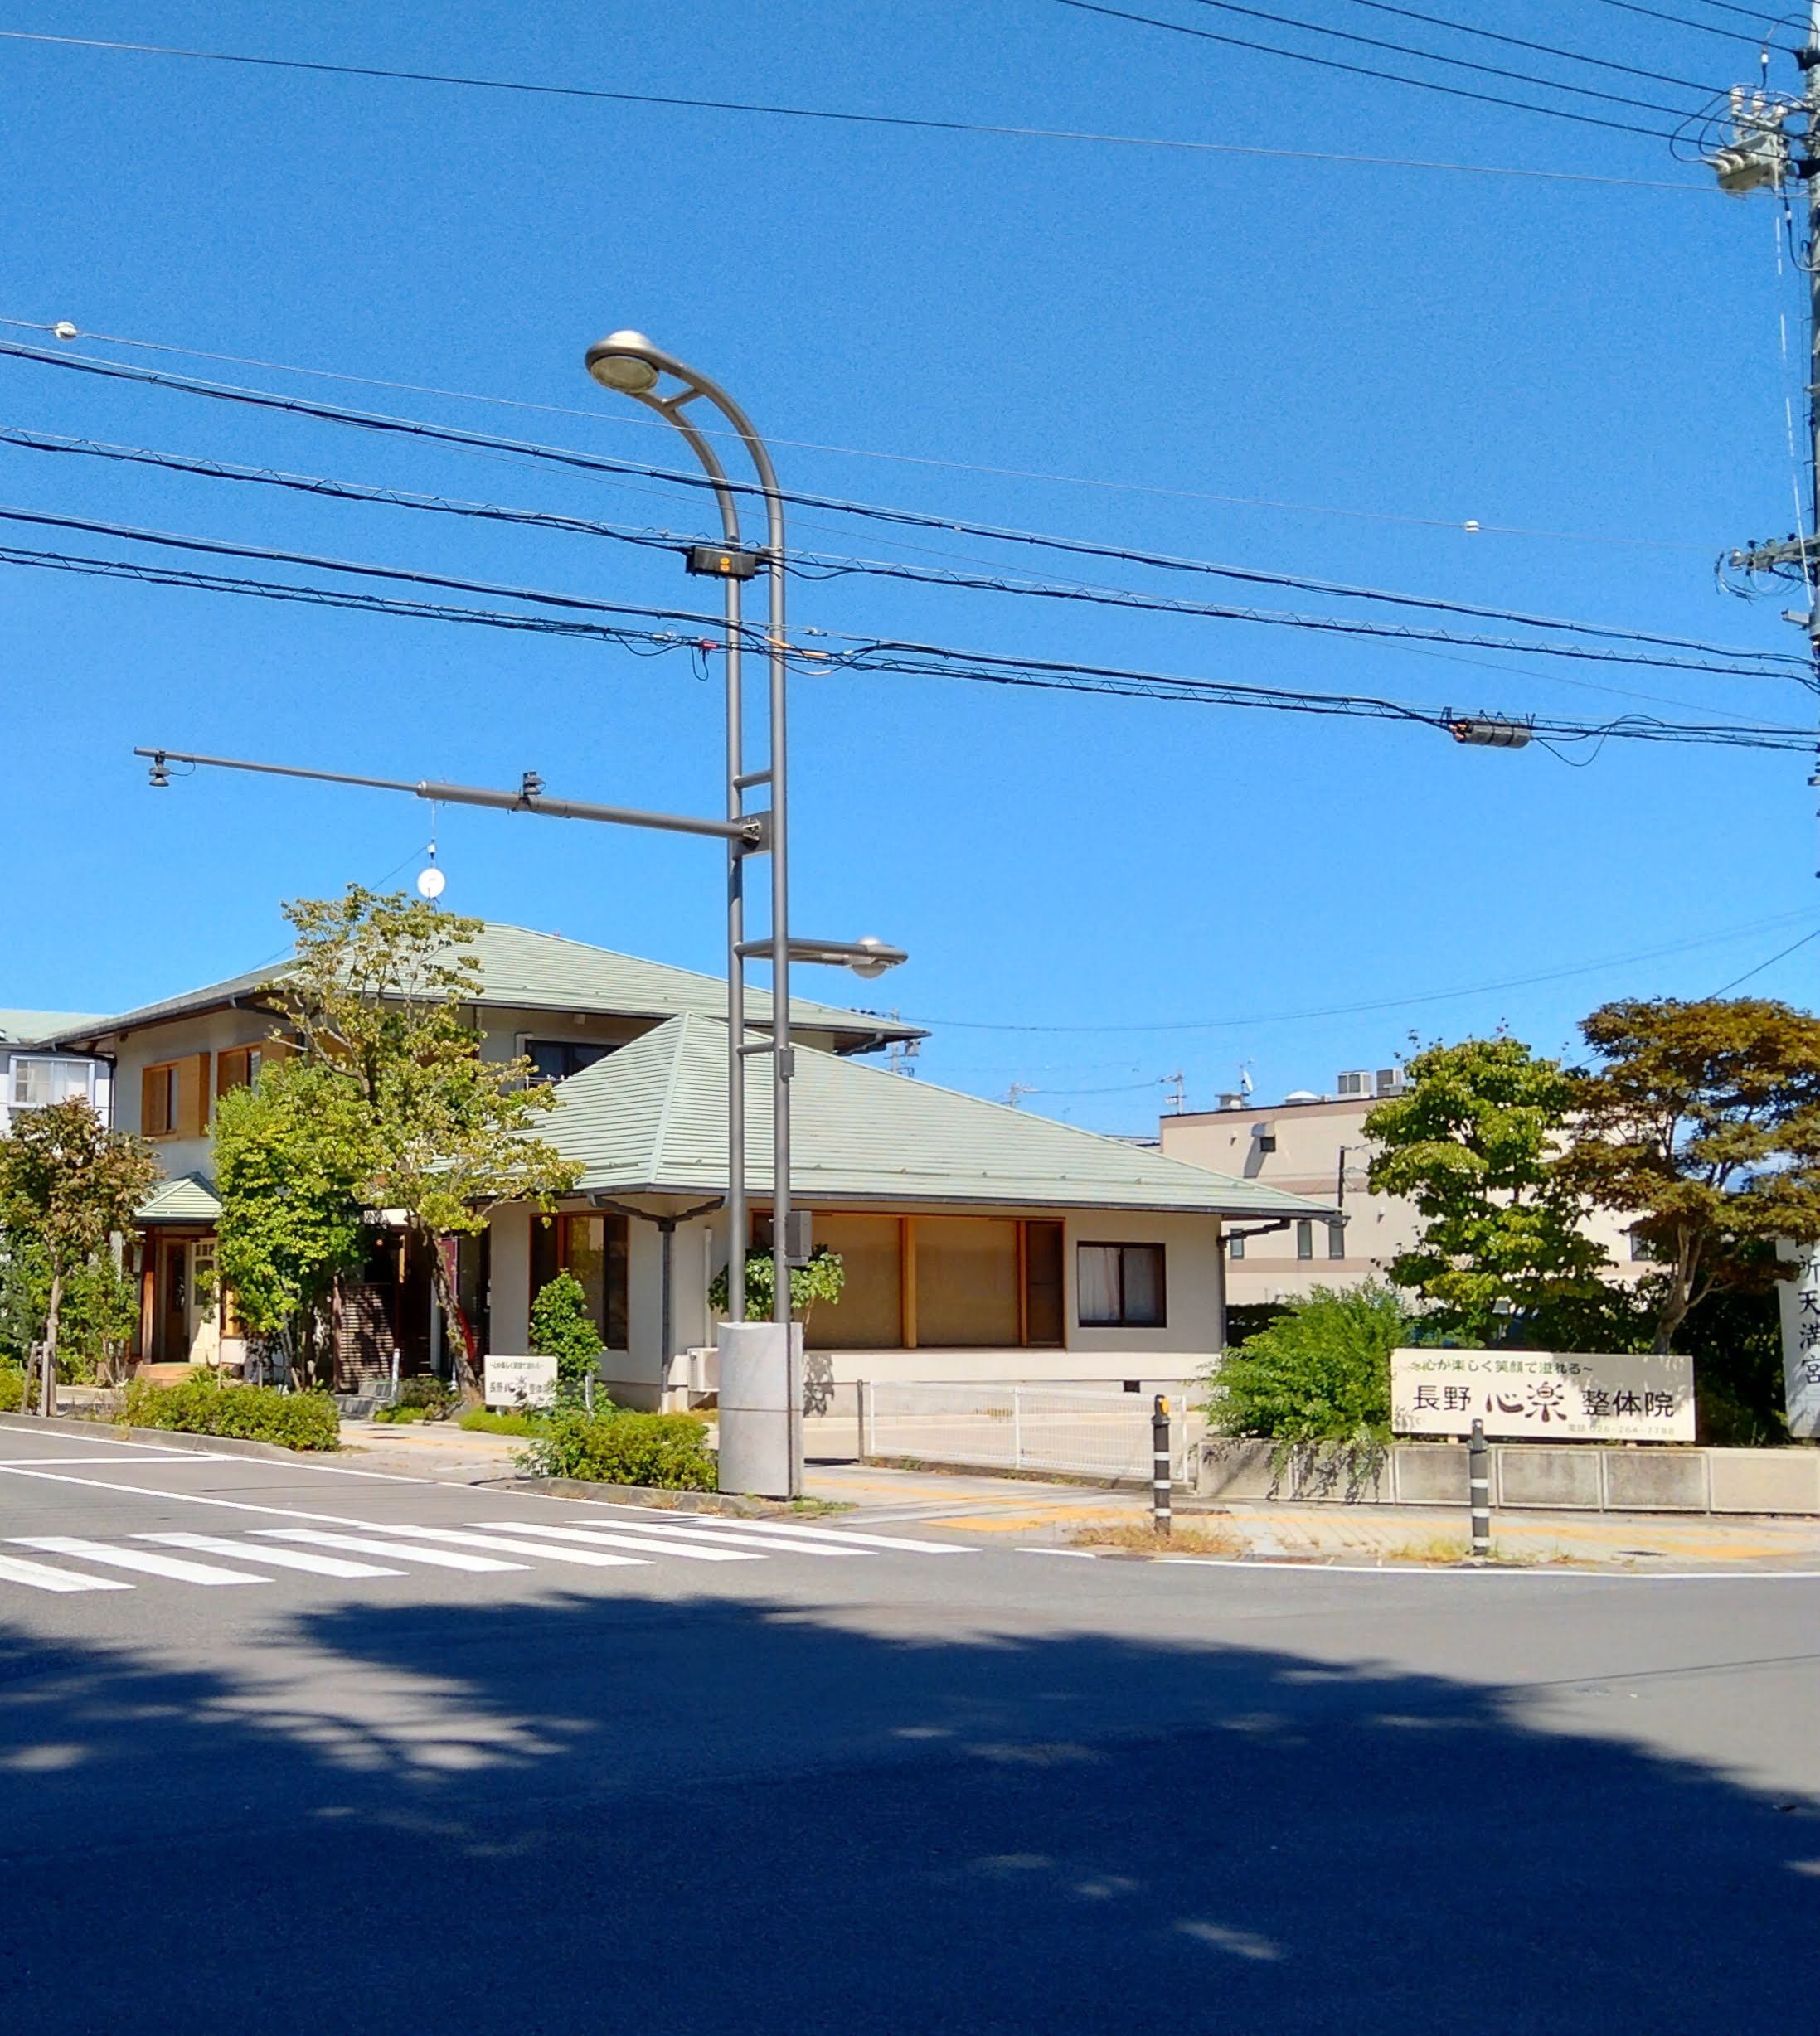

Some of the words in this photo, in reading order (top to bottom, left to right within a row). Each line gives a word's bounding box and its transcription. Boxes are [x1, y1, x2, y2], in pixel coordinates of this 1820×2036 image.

[1413, 1385, 1471, 1412] 長野
[1485, 1381, 1568, 1423] 心楽
[1581, 1389, 1674, 1418] 整体院
